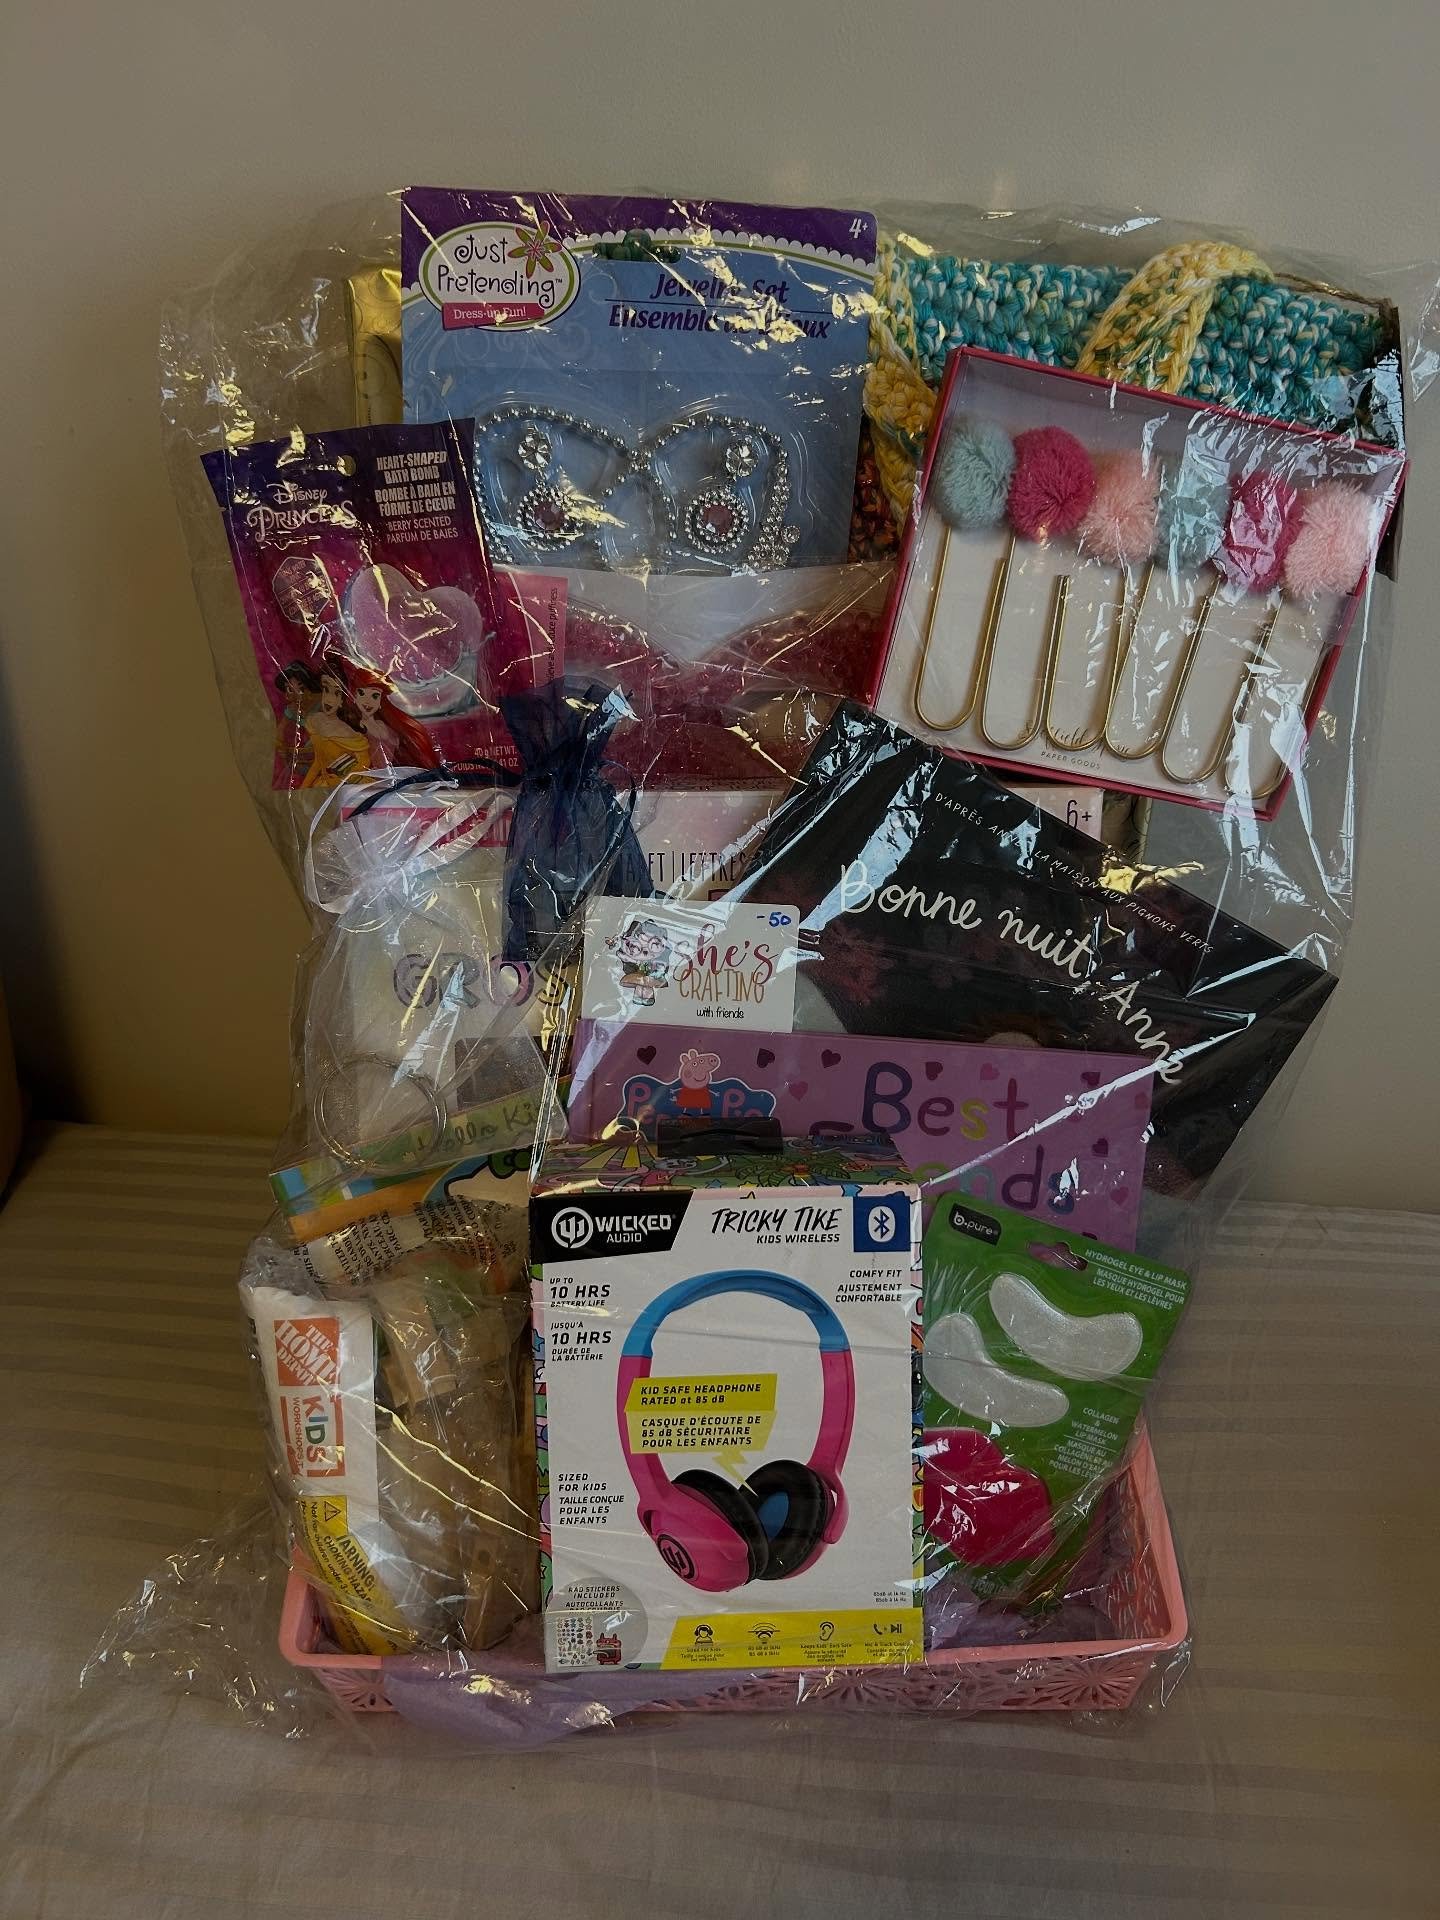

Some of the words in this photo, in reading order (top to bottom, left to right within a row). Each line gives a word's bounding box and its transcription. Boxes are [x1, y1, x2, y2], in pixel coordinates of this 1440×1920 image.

[454, 234, 508, 264] Just
[503, 305, 527, 317] Fun!
[377, 451, 447, 470] HEART-SHAPED
[384, 469, 409, 484] BATH
[410, 466, 440, 481] BOMB
[375, 487, 408, 502] BOMBE
[417, 483, 440, 498] BAIN
[442, 481, 455, 495] EN
[379, 501, 411, 516] FORME
[412, 500, 424, 513] DE
[388, 520, 411, 531] BERRY
[414, 516, 451, 528] SCENTED
[386, 532, 418, 543] PARFUM
[420, 530, 431, 540] DE
[434, 527, 458, 539] BAIES
[509, 758, 518, 766] OZ
[1041, 751, 1068, 761] PAPER
[1071, 758, 1101, 769] GOODS
[1034, 849, 1051, 863] LA
[1052, 858, 1099, 889] MAISON
[1101, 887, 1123, 904] AUX
[1126, 901, 1177, 933] PIGNONS
[1179, 929, 1214, 954] VERTS
[841, 860, 983, 930] Bonne
[1098, 980, 1184, 1084] Anne
[696, 1006, 713, 1018] with
[716, 1006, 744, 1019] friends
[862, 1061, 1029, 1142] Best
[595, 1214, 672, 1236] WICKED
[711, 1208, 788, 1234] TRICKY
[794, 1206, 843, 1232] TIKE
[607, 1232, 642, 1243] AUDIO
[756, 1235, 781, 1244] KIDS
[785, 1233, 840, 1243] WIRELESS
[849, 1270, 883, 1278] COMFY
[886, 1269, 902, 1278] FIT
[1084, 1248, 1128, 1269] HYDROGEL
[1128, 1264, 1144, 1275] EYE
[1150, 1271, 1163, 1281] LIP
[1163, 1275, 1186, 1290] MASK
[550, 1286, 568, 1299] 10
[575, 1284, 611, 1298] HRS
[838, 1283, 902, 1292] AJUSTEMENT
[1092, 1277, 1106, 1287] LES
[1105, 1281, 1125, 1294] YEUX
[1125, 1288, 1133, 1296] ET
[1134, 1291, 1147, 1301] LES
[1095, 1268, 1127, 1285] MASQUE
[1127, 1279, 1164, 1297] HYDROGEL
[1164, 1292, 1184, 1304] POUR
[835, 1294, 902, 1303] CONFORTABLE
[551, 1332, 570, 1345] 10
[577, 1331, 611, 1344] HRS
[641, 1386, 659, 1395] KID
[663, 1386, 691, 1394] SAFE
[694, 1384, 761, 1394] HEADPHONE
[641, 1396, 677, 1405] RATED
[695, 1396, 708, 1404] 85
[711, 1395, 725, 1403] dB
[641, 1417, 685, 1428] CASQUE
[690, 1415, 743, 1426] D'ÉCOUTE
[747, 1416, 761, 1424] DE
[1082, 1406, 1120, 1424] COLLAGEN
[302, 1395, 329, 1463] KIDS
[659, 1429, 672, 1437] dB
[676, 1426, 750, 1436] SÉCURITAIRE
[1070, 1420, 1118, 1441] WATERMELON
[642, 1439, 672, 1448] POUR
[677, 1439, 696, 1447] LES
[701, 1437, 752, 1447] ENFANTS
[1086, 1433, 1107, 1445] MASK
[558, 1473, 588, 1481] SIZED
[558, 1484, 579, 1492] FOR
[583, 1483, 607, 1491] KIDS
[559, 1496, 588, 1504] TAILLE
[590, 1495, 624, 1504] CONÇUE
[559, 1506, 587, 1514] POUR
[592, 1506, 610, 1514] LES
[559, 1516, 607, 1525] ENFANTS
[323, 1535, 352, 1577] CHOKING
[348, 1573, 373, 1602] HAZAR
